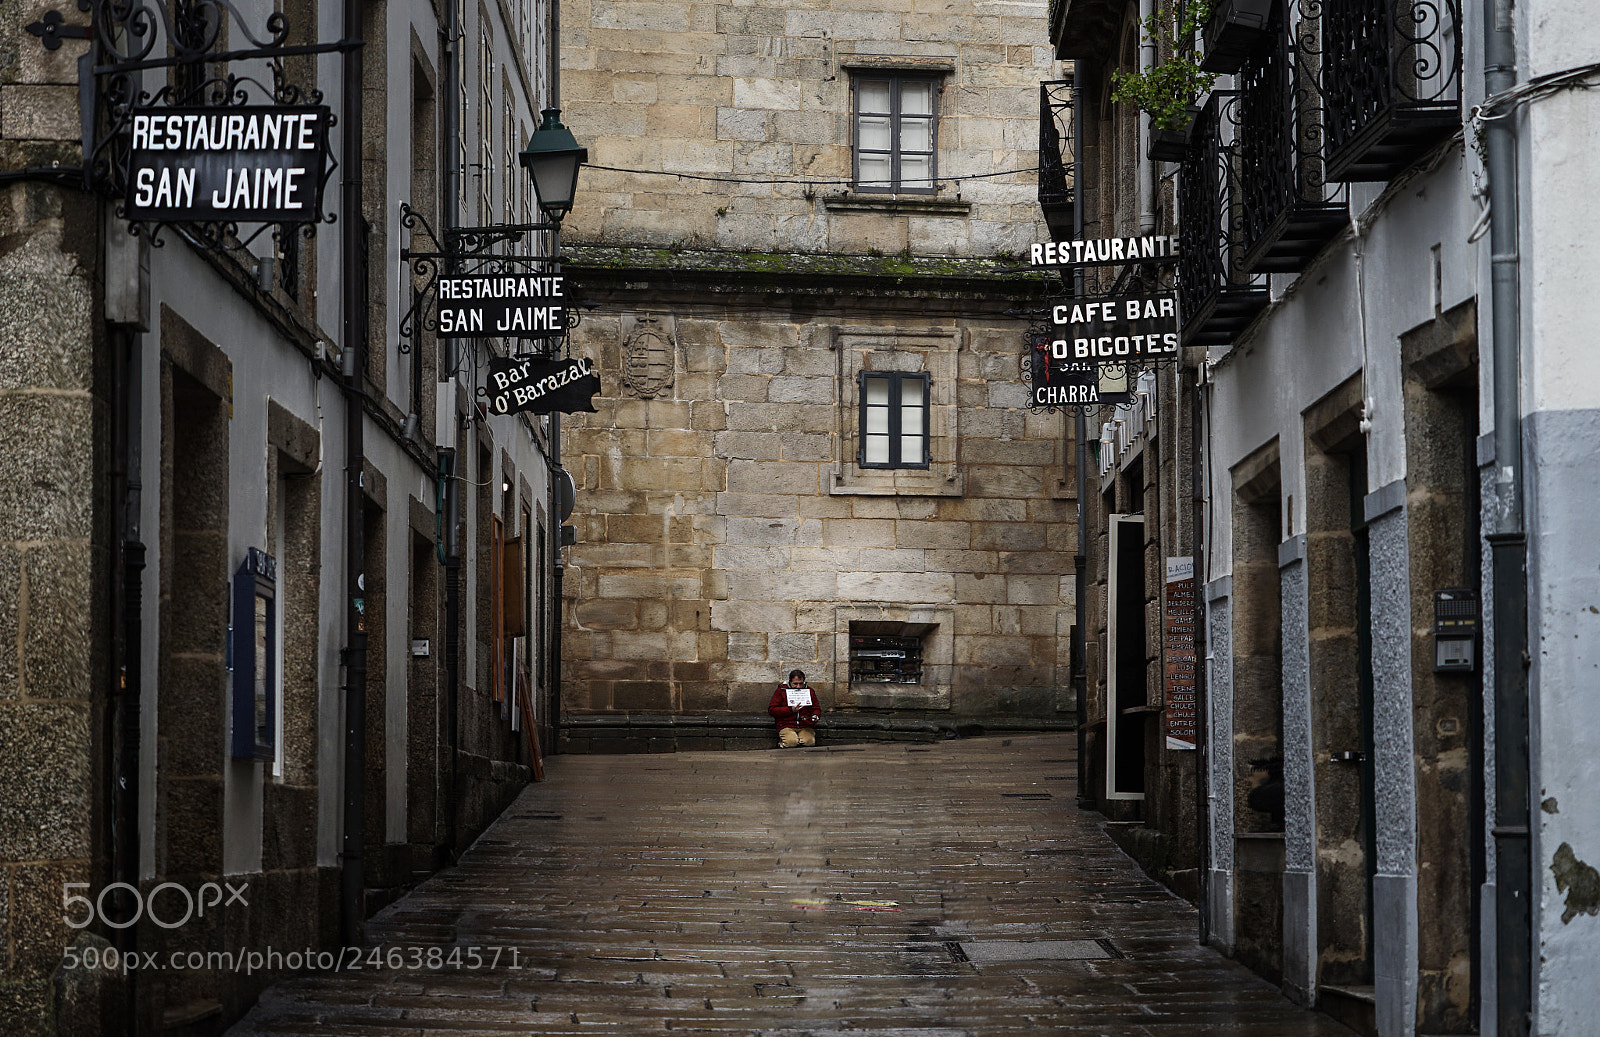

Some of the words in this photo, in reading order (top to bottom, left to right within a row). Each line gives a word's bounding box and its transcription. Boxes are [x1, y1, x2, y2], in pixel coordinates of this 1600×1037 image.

[132, 113, 318, 150] RESTAURANTE
[135, 167, 196, 209] SAN
[212, 167, 306, 210] JAIME
[1030, 235, 1180, 265] RESTAURANTE
[439, 276, 564, 300] RESTAURANTE
[440, 308, 483, 333] SAN
[496, 306, 562, 331] JAIME
[1052, 302, 1117, 325] CAFE
[1126, 298, 1175, 320] BAR
[1052, 339, 1068, 359] O
[1074, 333, 1178, 358] BIGOTES
[493, 361, 531, 390] Bar
[1036, 384, 1099, 404] CHARRA
